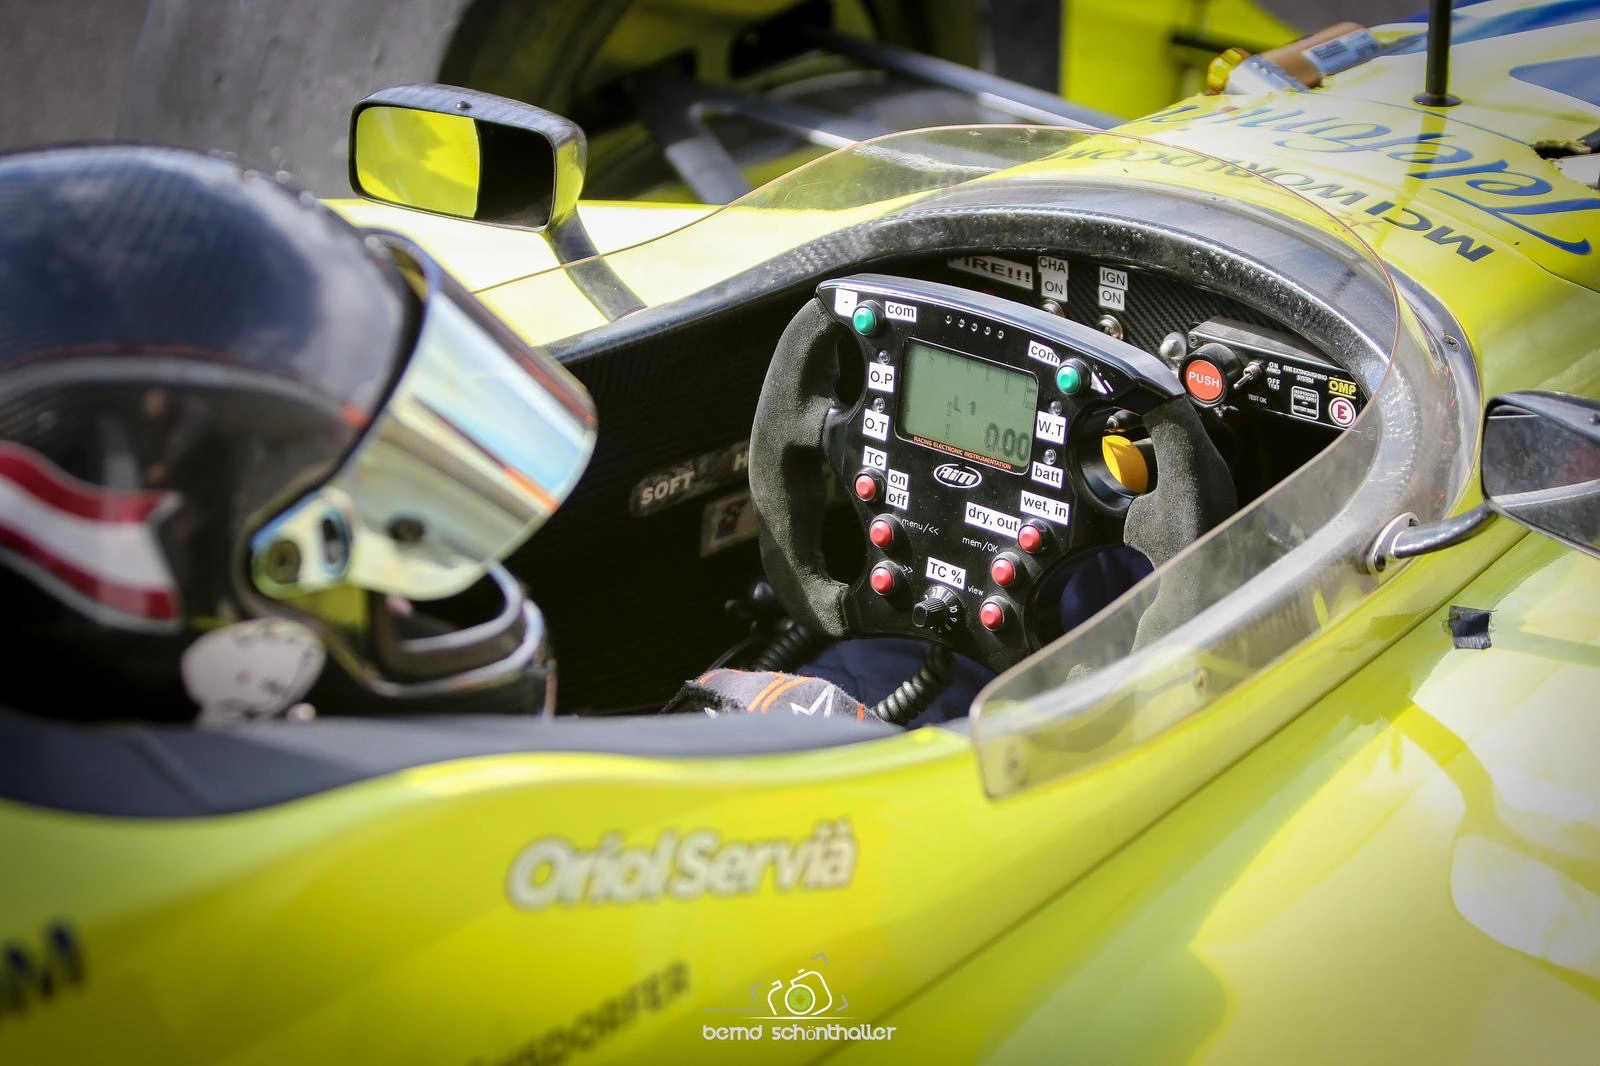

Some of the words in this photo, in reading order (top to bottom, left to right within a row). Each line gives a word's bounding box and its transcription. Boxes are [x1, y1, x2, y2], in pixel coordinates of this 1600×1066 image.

[1365, 200, 1497, 262] MCI
[1038, 257, 1067, 274] CHA
[1102, 270, 1126, 286] IGN
[1044, 280, 1064, 295] ON
[1102, 289, 1122, 304] ON
[887, 304, 915, 318] com
[1030, 345, 1059, 363] com
[1268, 361, 1279, 369] ON
[870, 370, 893, 385] O.P
[1188, 371, 1220, 389] PUSH
[1328, 380, 1357, 395] OMP
[1259, 396, 1267, 404] OK
[864, 417, 888, 433] O.T
[1038, 419, 1064, 437] W.T
[867, 451, 884, 467] TC
[913, 436, 933, 447] RACING
[933, 441, 964, 455] ELECTRONIC
[963, 451, 1012, 470] INSTRUMENTATION
[890, 473, 906, 486] on
[1034, 465, 1061, 483] batt
[640, 471, 695, 505] SOFT
[888, 493, 907, 507] off
[1023, 496, 1050, 514] wet,
[1055, 503, 1067, 518] in
[968, 506, 993, 526] dry,
[996, 516, 1018, 533] out
[962, 536, 999, 553] mem/OK
[930, 561, 947, 578] TC
[951, 569, 963, 585] %
[967, 585, 984, 596] view
